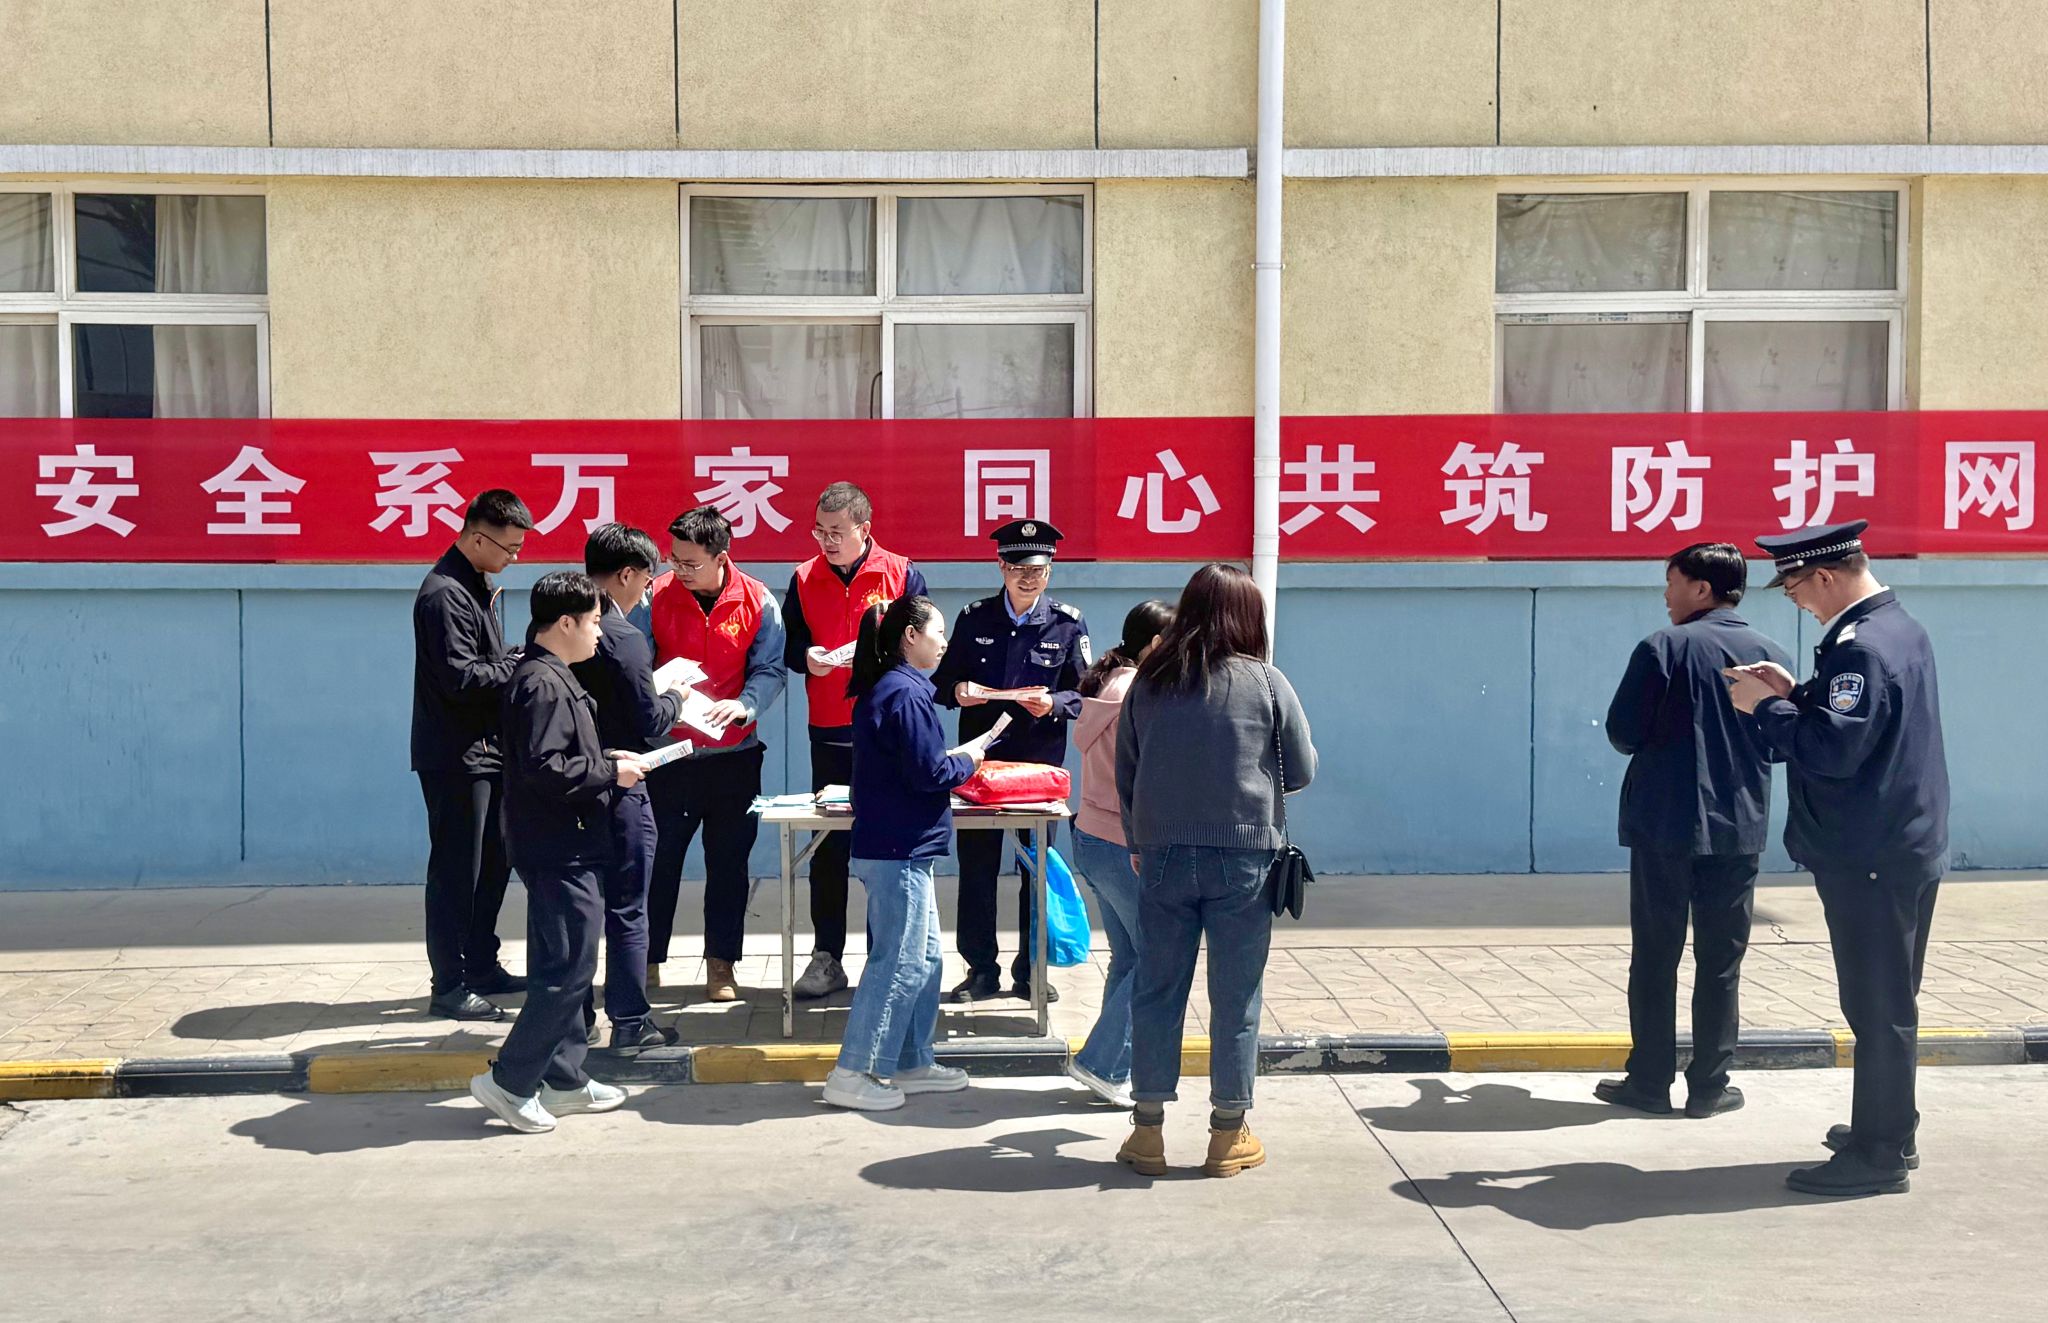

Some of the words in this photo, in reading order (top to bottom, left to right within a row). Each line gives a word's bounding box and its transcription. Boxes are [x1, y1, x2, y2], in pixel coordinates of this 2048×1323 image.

[36, 444, 793, 538] 安全系万家
[964, 438, 2036, 538] 同心共筑防护网
